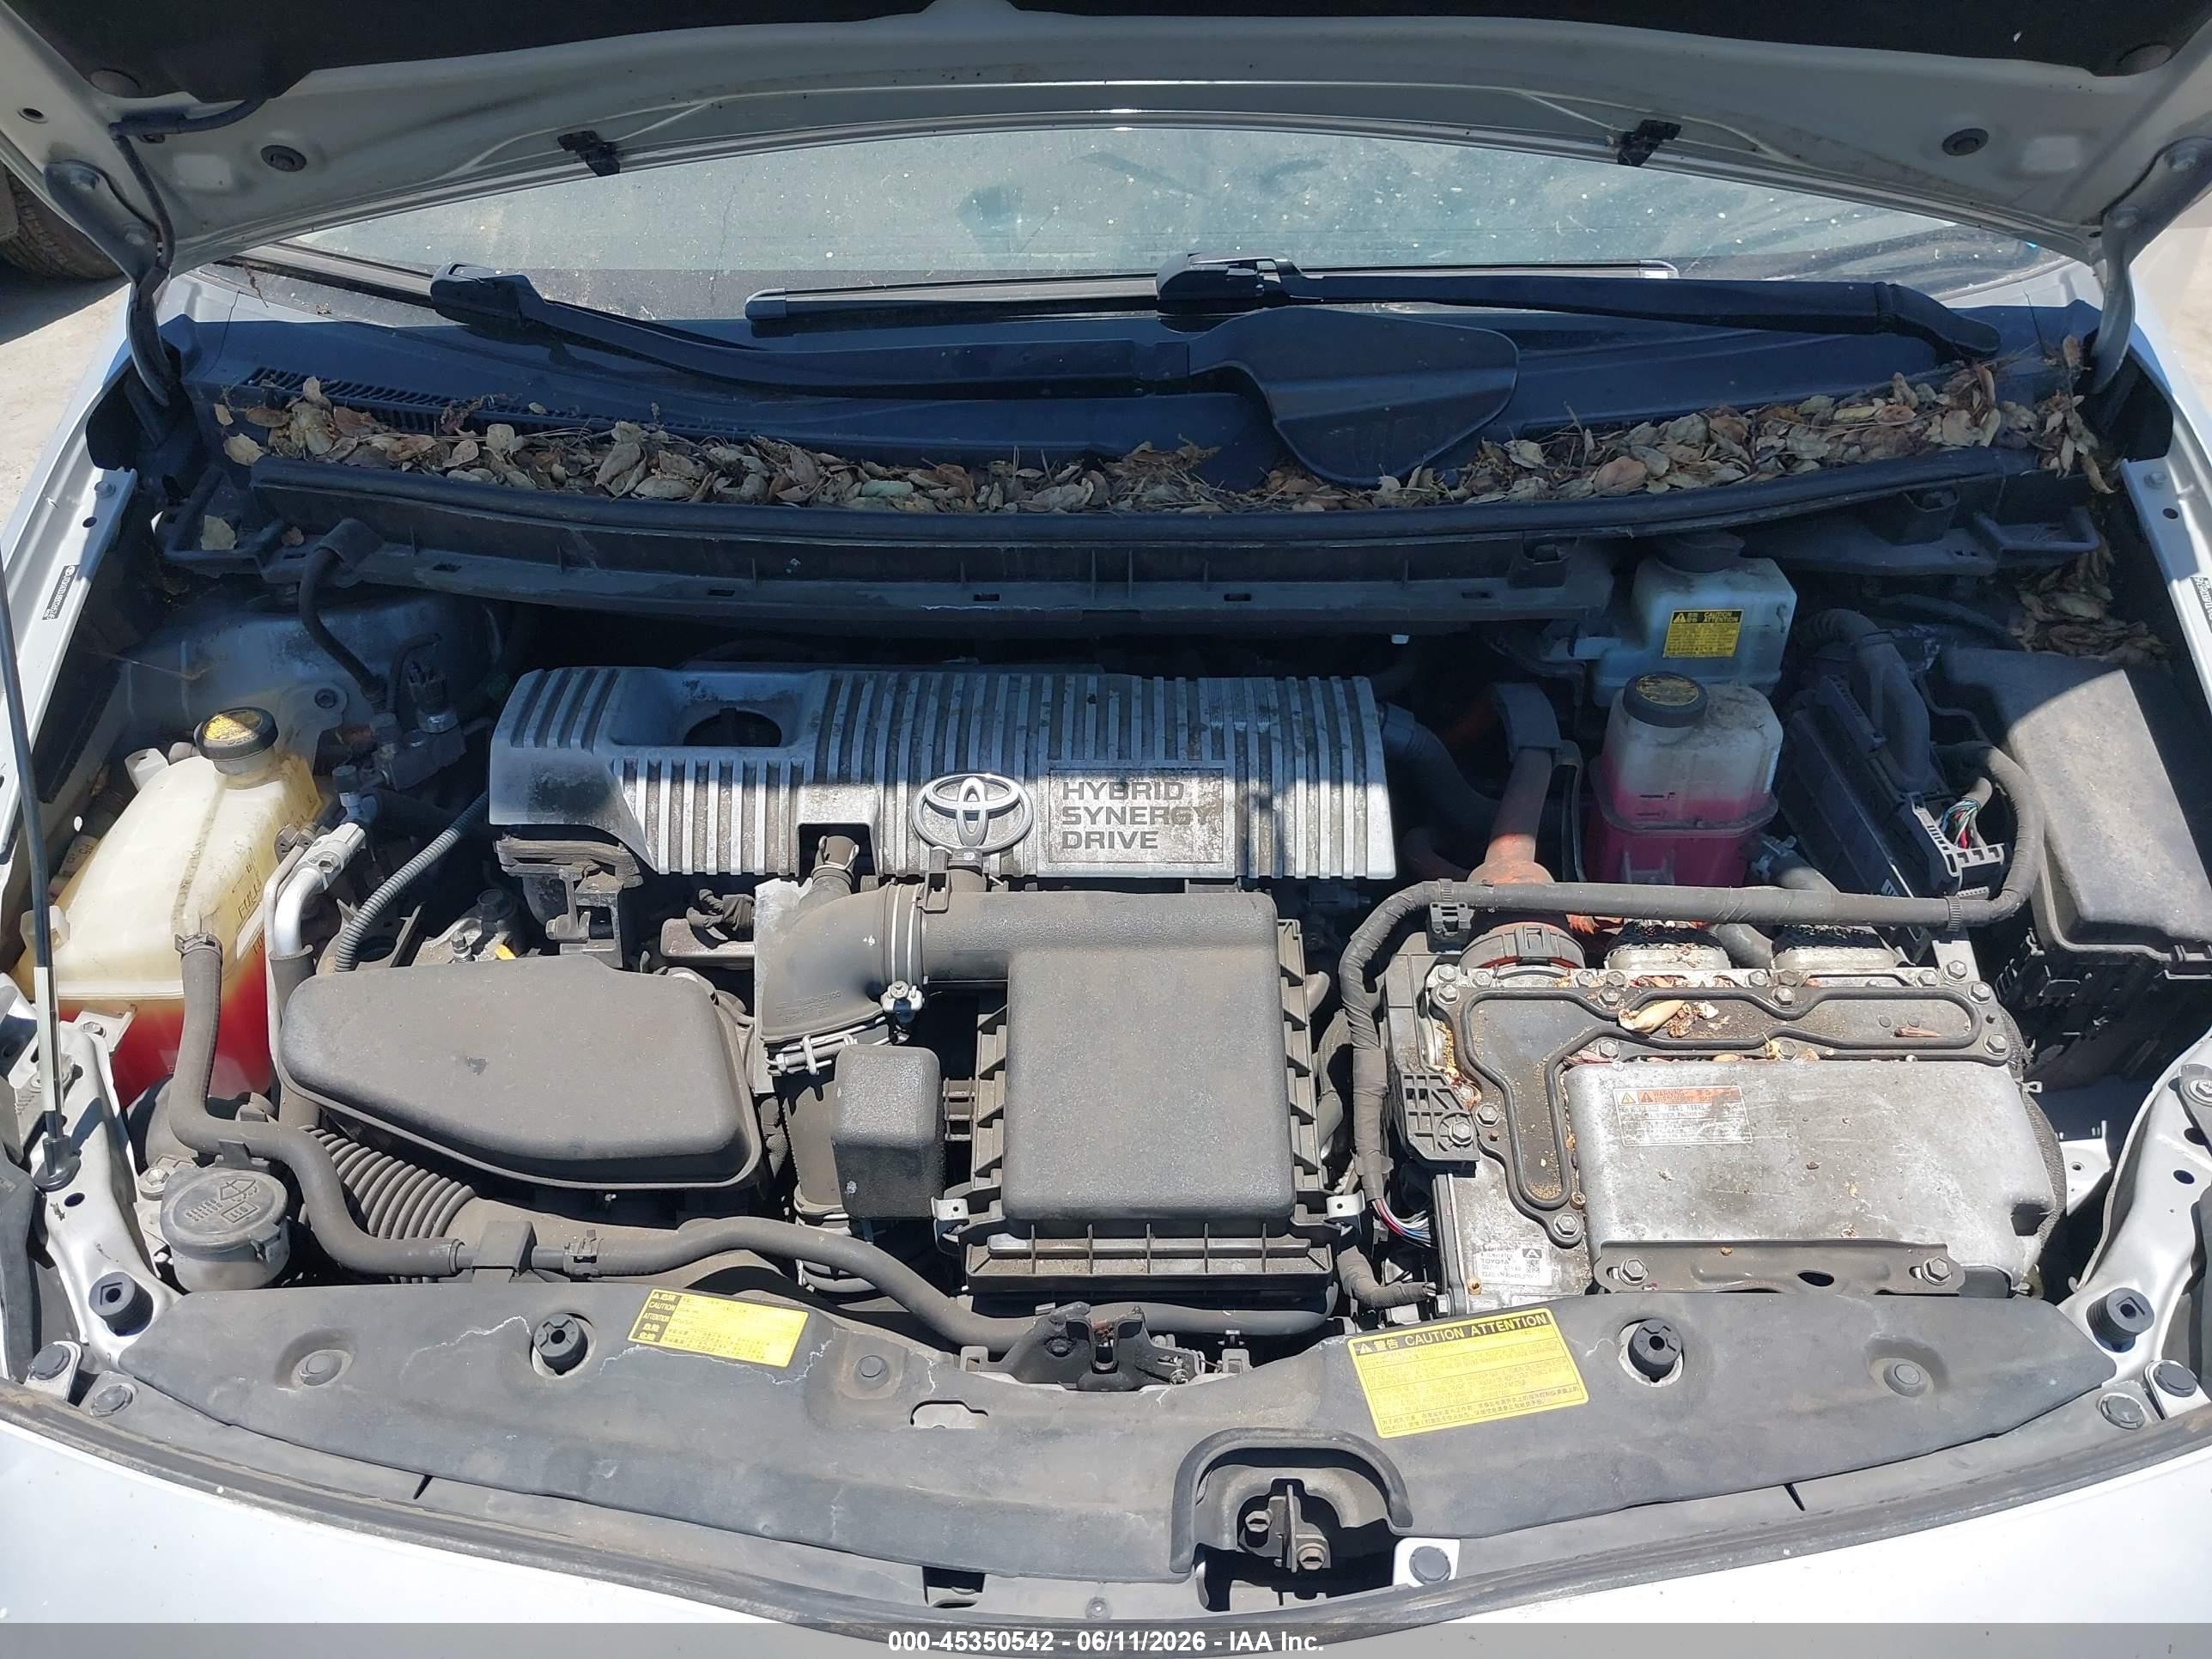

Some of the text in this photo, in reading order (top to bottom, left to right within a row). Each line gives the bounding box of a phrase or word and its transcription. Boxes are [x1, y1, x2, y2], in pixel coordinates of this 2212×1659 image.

[1062, 781, 1185, 800] HYBRID
[1061, 805, 1214, 825] SYNERGY
[1061, 830, 1159, 849] DRIVE
[648, 1301, 677, 1311] CAUTION
[642, 1312, 671, 1323] ATTENTION
[1374, 1312, 1547, 1352] 警告 CAUTION ATTENTION
